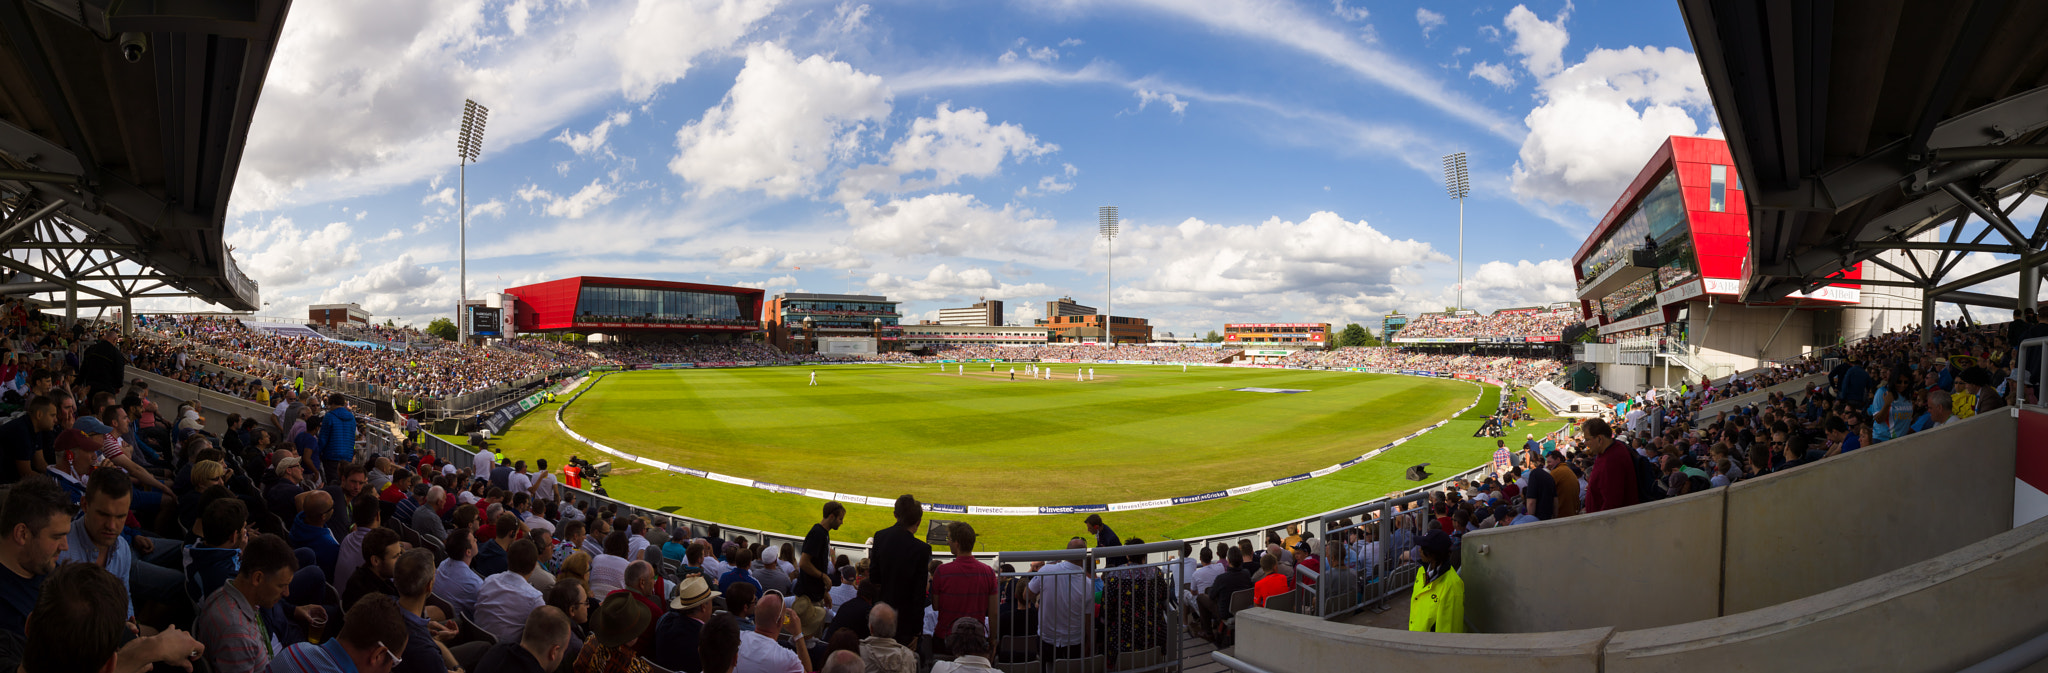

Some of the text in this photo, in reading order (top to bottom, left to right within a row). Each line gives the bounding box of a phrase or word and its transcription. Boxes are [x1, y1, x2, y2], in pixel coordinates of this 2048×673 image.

[1717, 280, 1739, 294] AJBe
[1829, 288, 1854, 300] AJBell
[1231, 485, 1252, 495] Investec
[841, 494, 866, 503] Investec
[975, 506, 1003, 514] Investec
